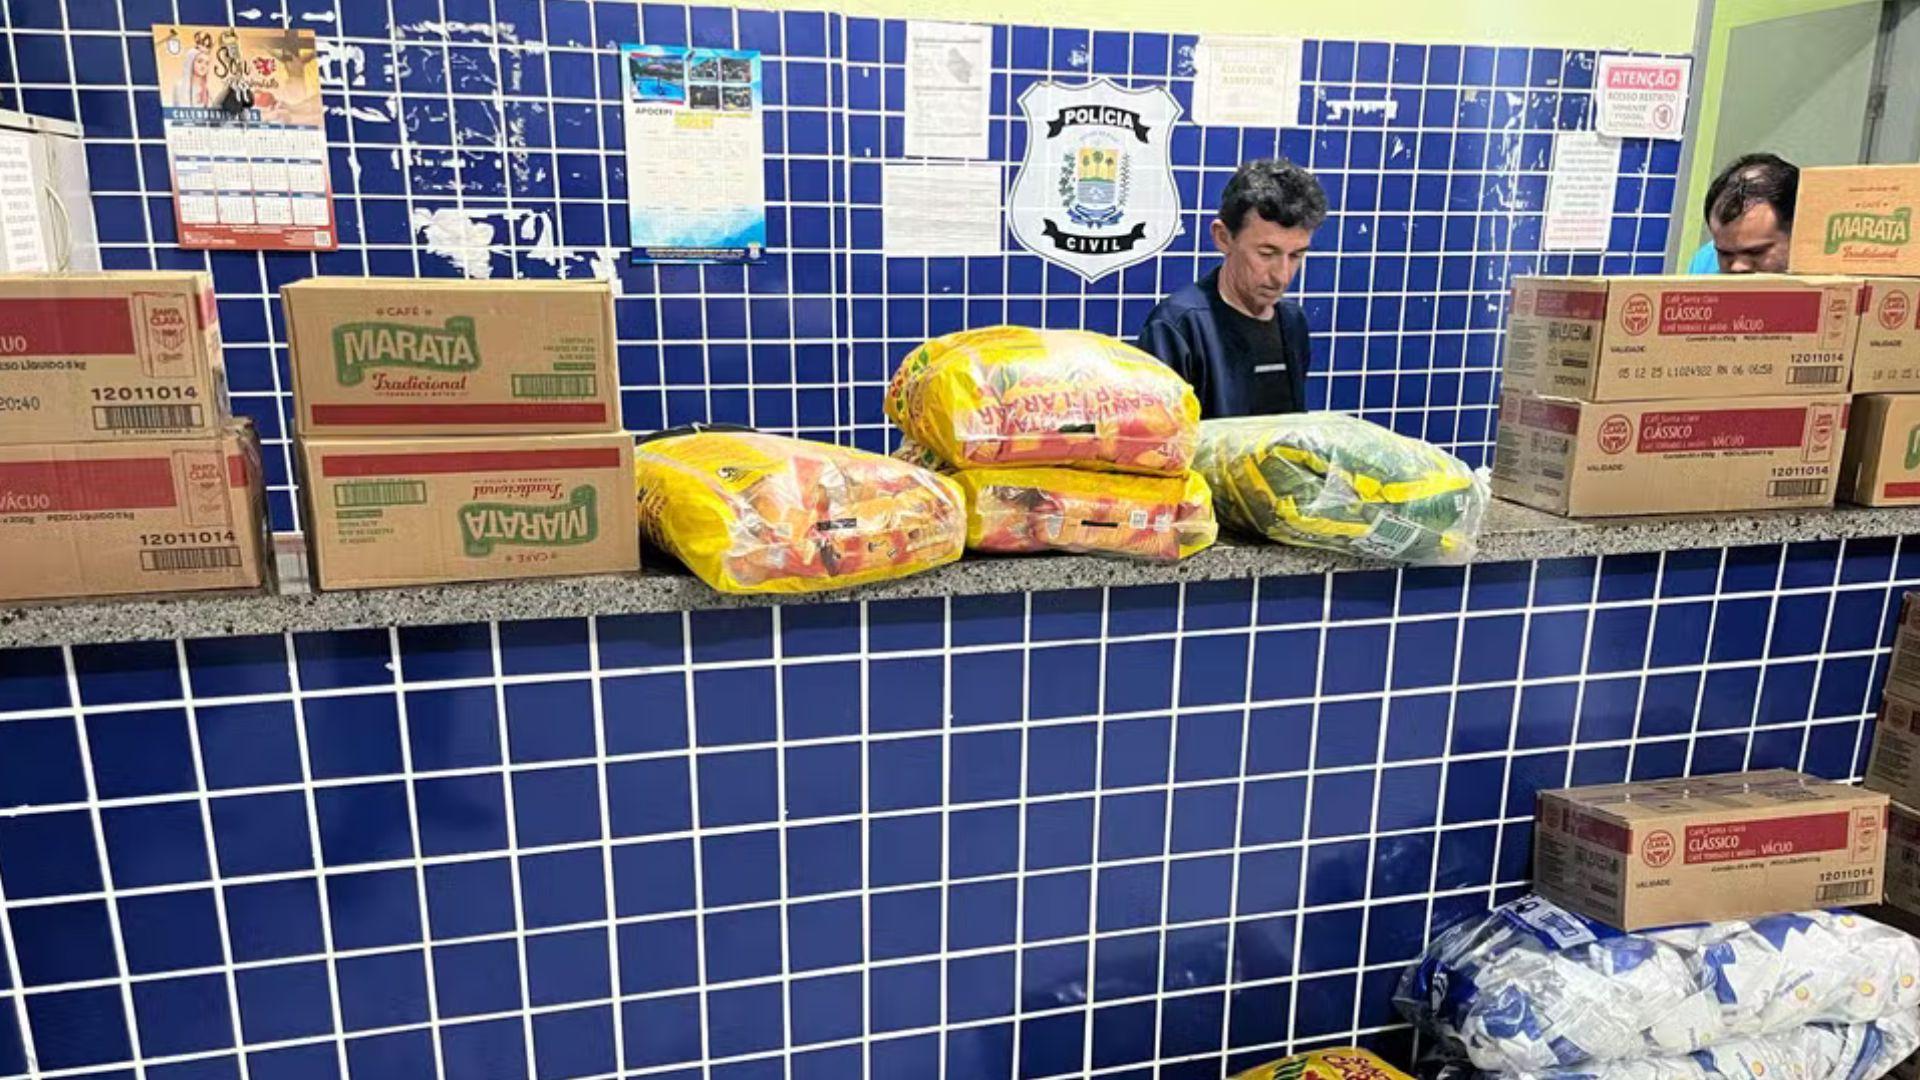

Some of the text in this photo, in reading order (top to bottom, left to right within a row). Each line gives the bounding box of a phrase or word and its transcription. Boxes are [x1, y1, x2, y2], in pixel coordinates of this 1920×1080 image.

[1611, 69, 1677, 88] ATENÇÃO
[1064, 106, 1134, 129] POLÍCIA
[1066, 236, 1121, 252] CIVIL
[386, 306, 420, 317] CAFÉ
[1664, 303, 1713, 320] CLÁSSICO
[1733, 314, 1765, 331] VÁCUO
[1610, 345, 1646, 353] VALIDADE
[1790, 353, 1845, 364] 12011014
[372, 372, 467, 392] Tradicional
[91, 386, 198, 401] 12011014
[1643, 423, 1692, 440] CLÁSSICO
[1712, 432, 1745, 448] VÁCUO
[1587, 463, 1624, 471] VALIDADE
[1771, 466, 1829, 478] 12011014
[472, 482, 565, 500] Tradicional
[139, 530, 236, 546] 12011014
[1689, 833, 1739, 853] CLÁSSICO
[1761, 840, 1793, 855] VÁCUO
[1820, 866, 1874, 882] 12011014
